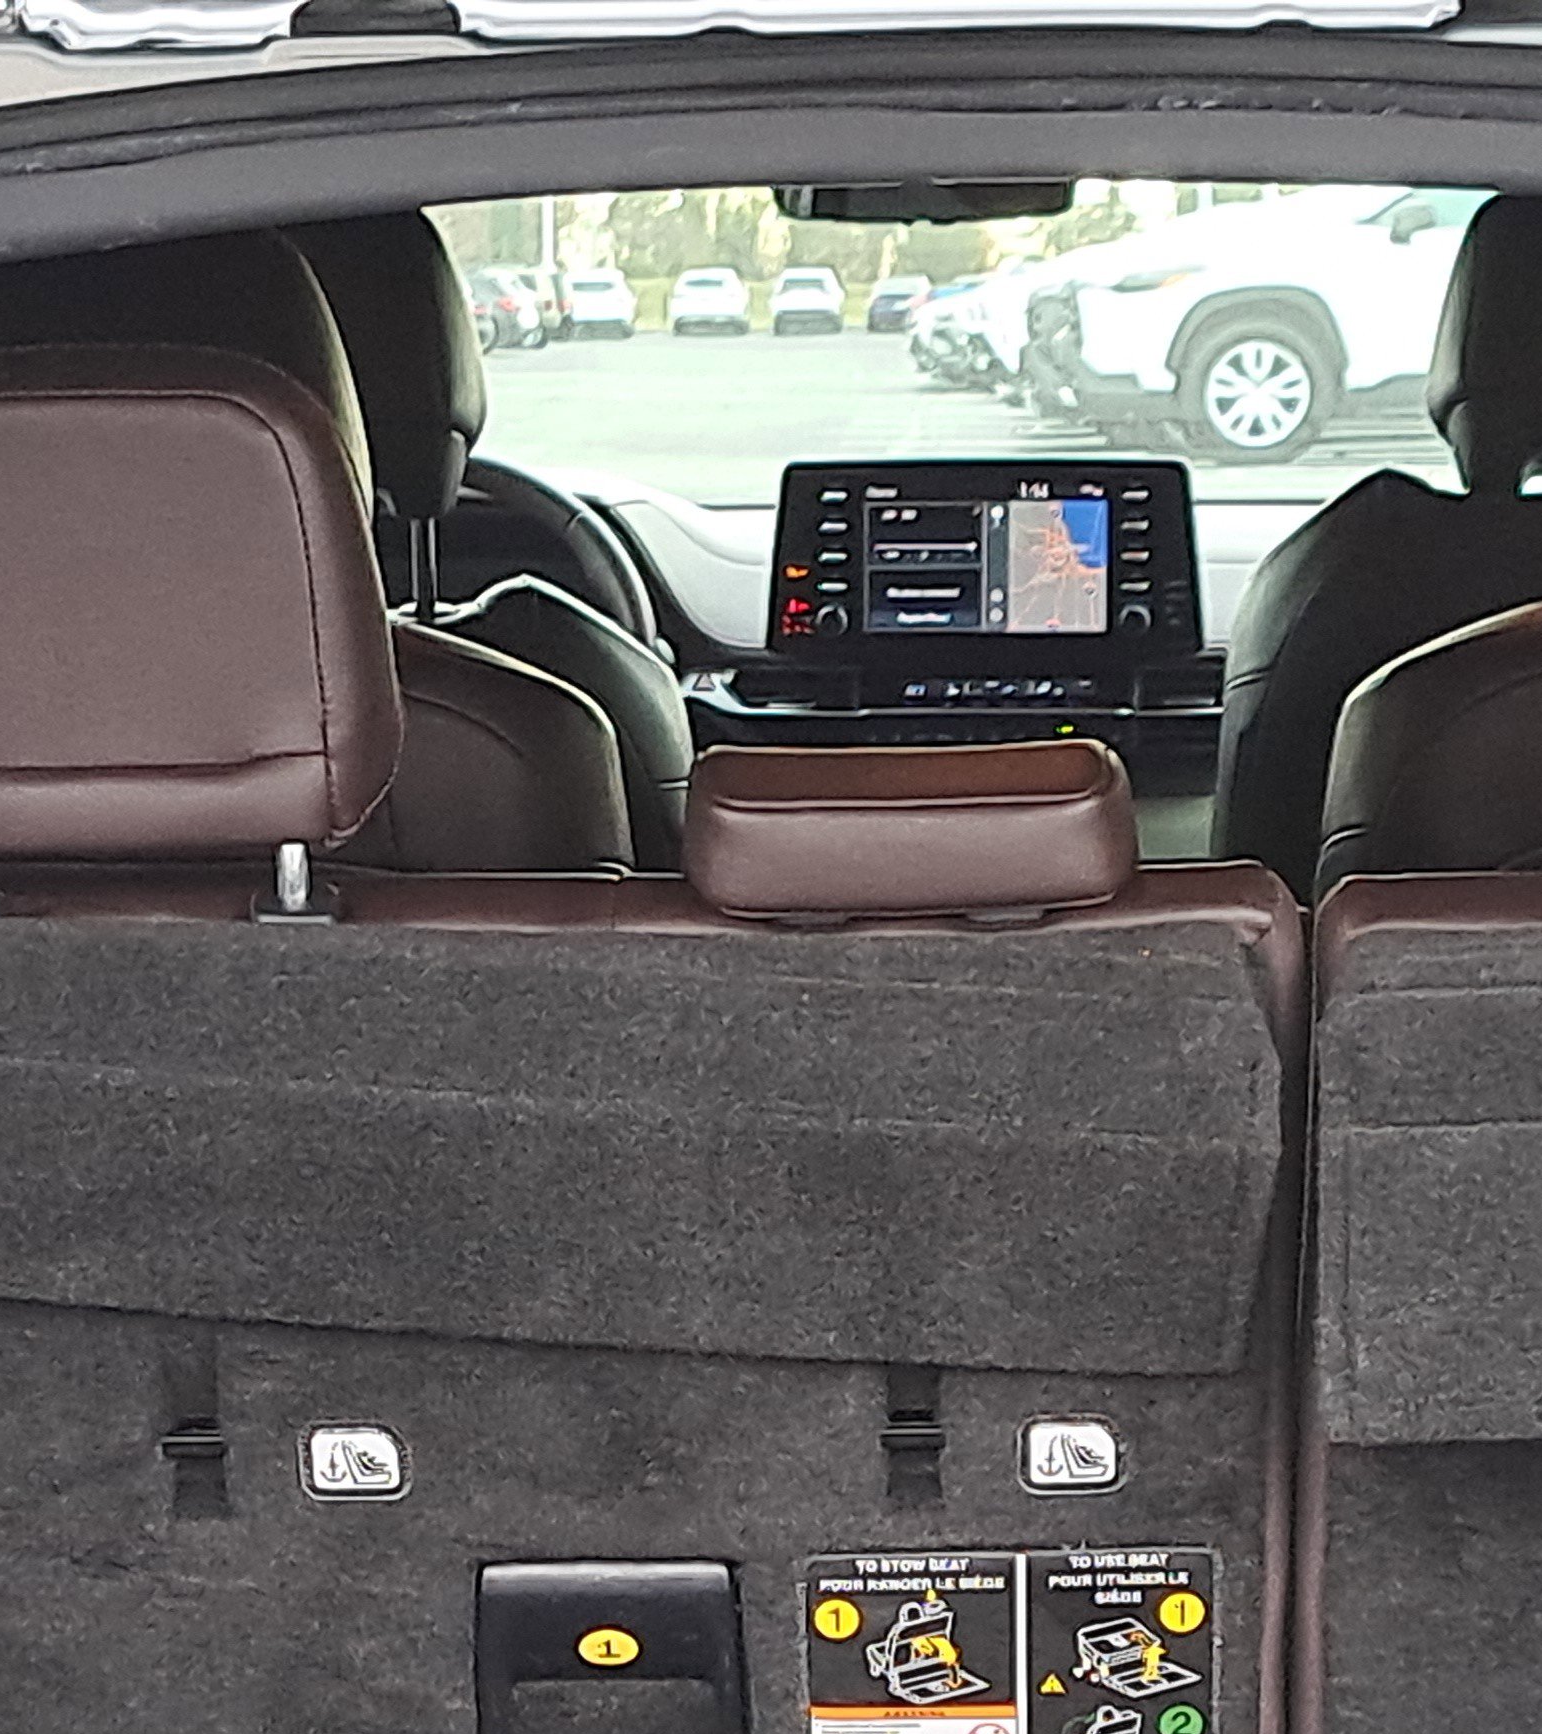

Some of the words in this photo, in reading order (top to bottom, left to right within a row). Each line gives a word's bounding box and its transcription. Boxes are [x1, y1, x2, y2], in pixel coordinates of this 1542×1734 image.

[855, 1558, 878, 1574] TO
[1068, 1555, 1091, 1569] TO
[1048, 1573, 1093, 1588] POUR
